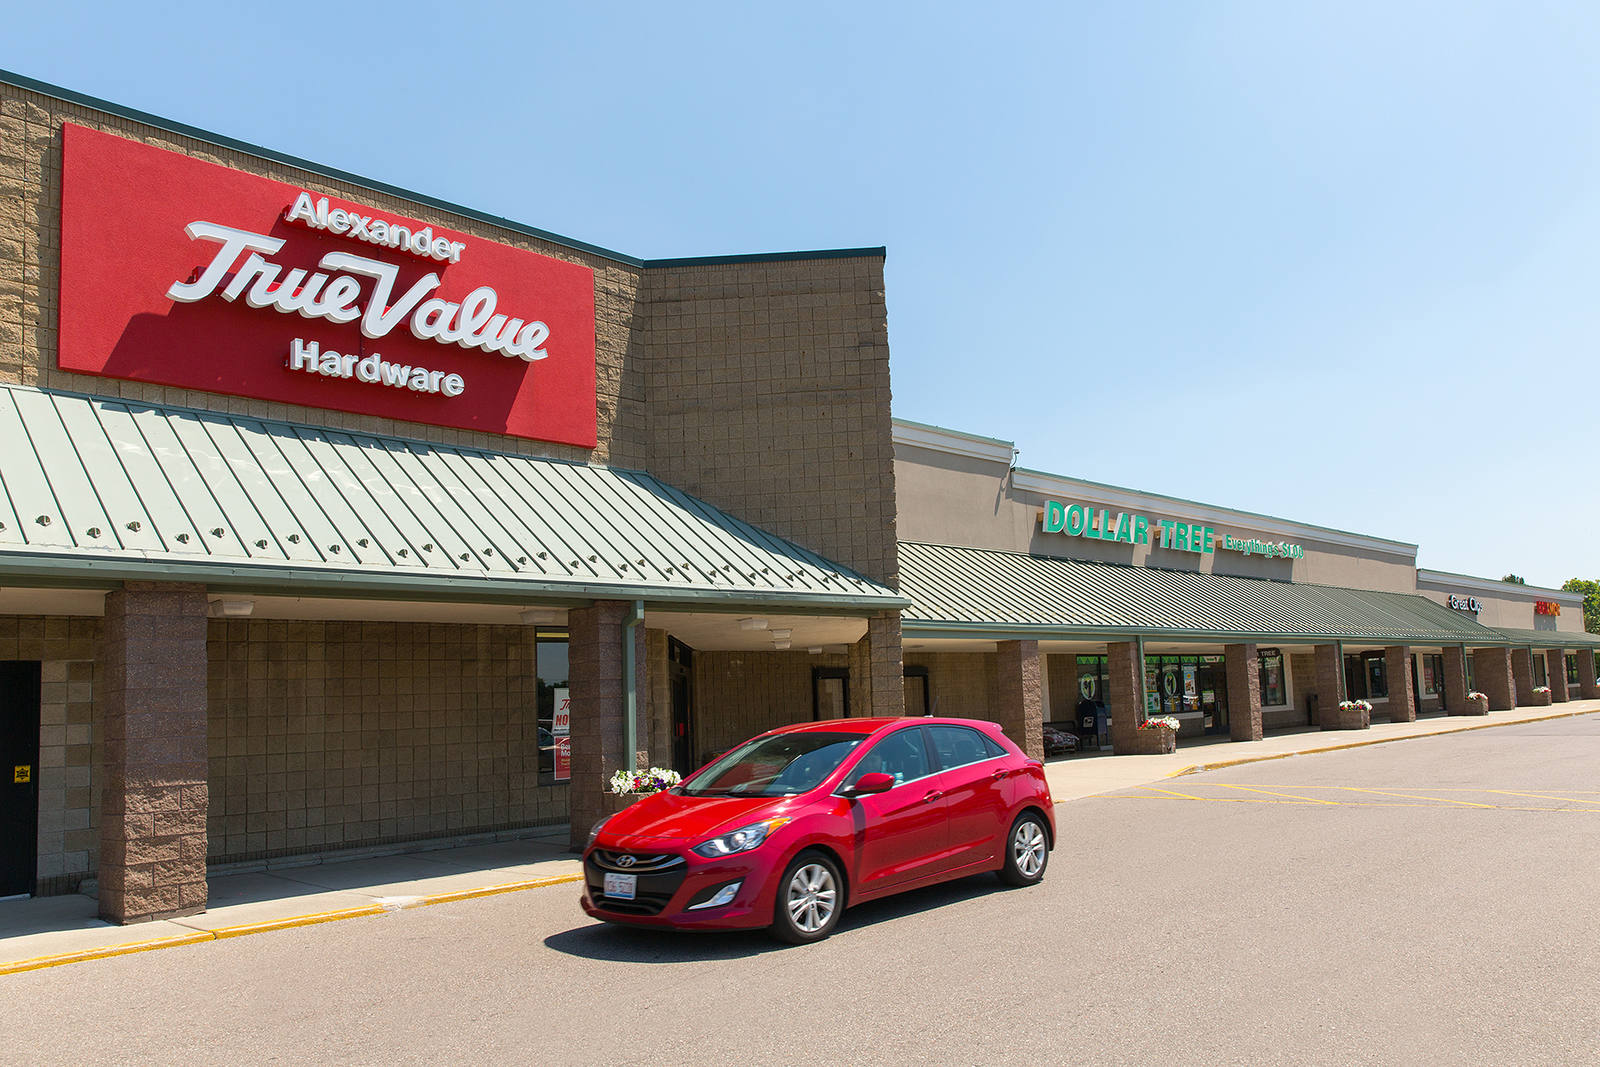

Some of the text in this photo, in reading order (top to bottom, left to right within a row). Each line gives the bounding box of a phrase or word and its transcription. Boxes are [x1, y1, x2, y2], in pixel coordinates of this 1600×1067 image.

[286, 191, 466, 263] Alexander
[165, 220, 549, 362] True Value
[290, 338, 465, 397] Hardware
[1042, 500, 1149, 545] DOLLAR
[1157, 519, 1214, 554] TREE
